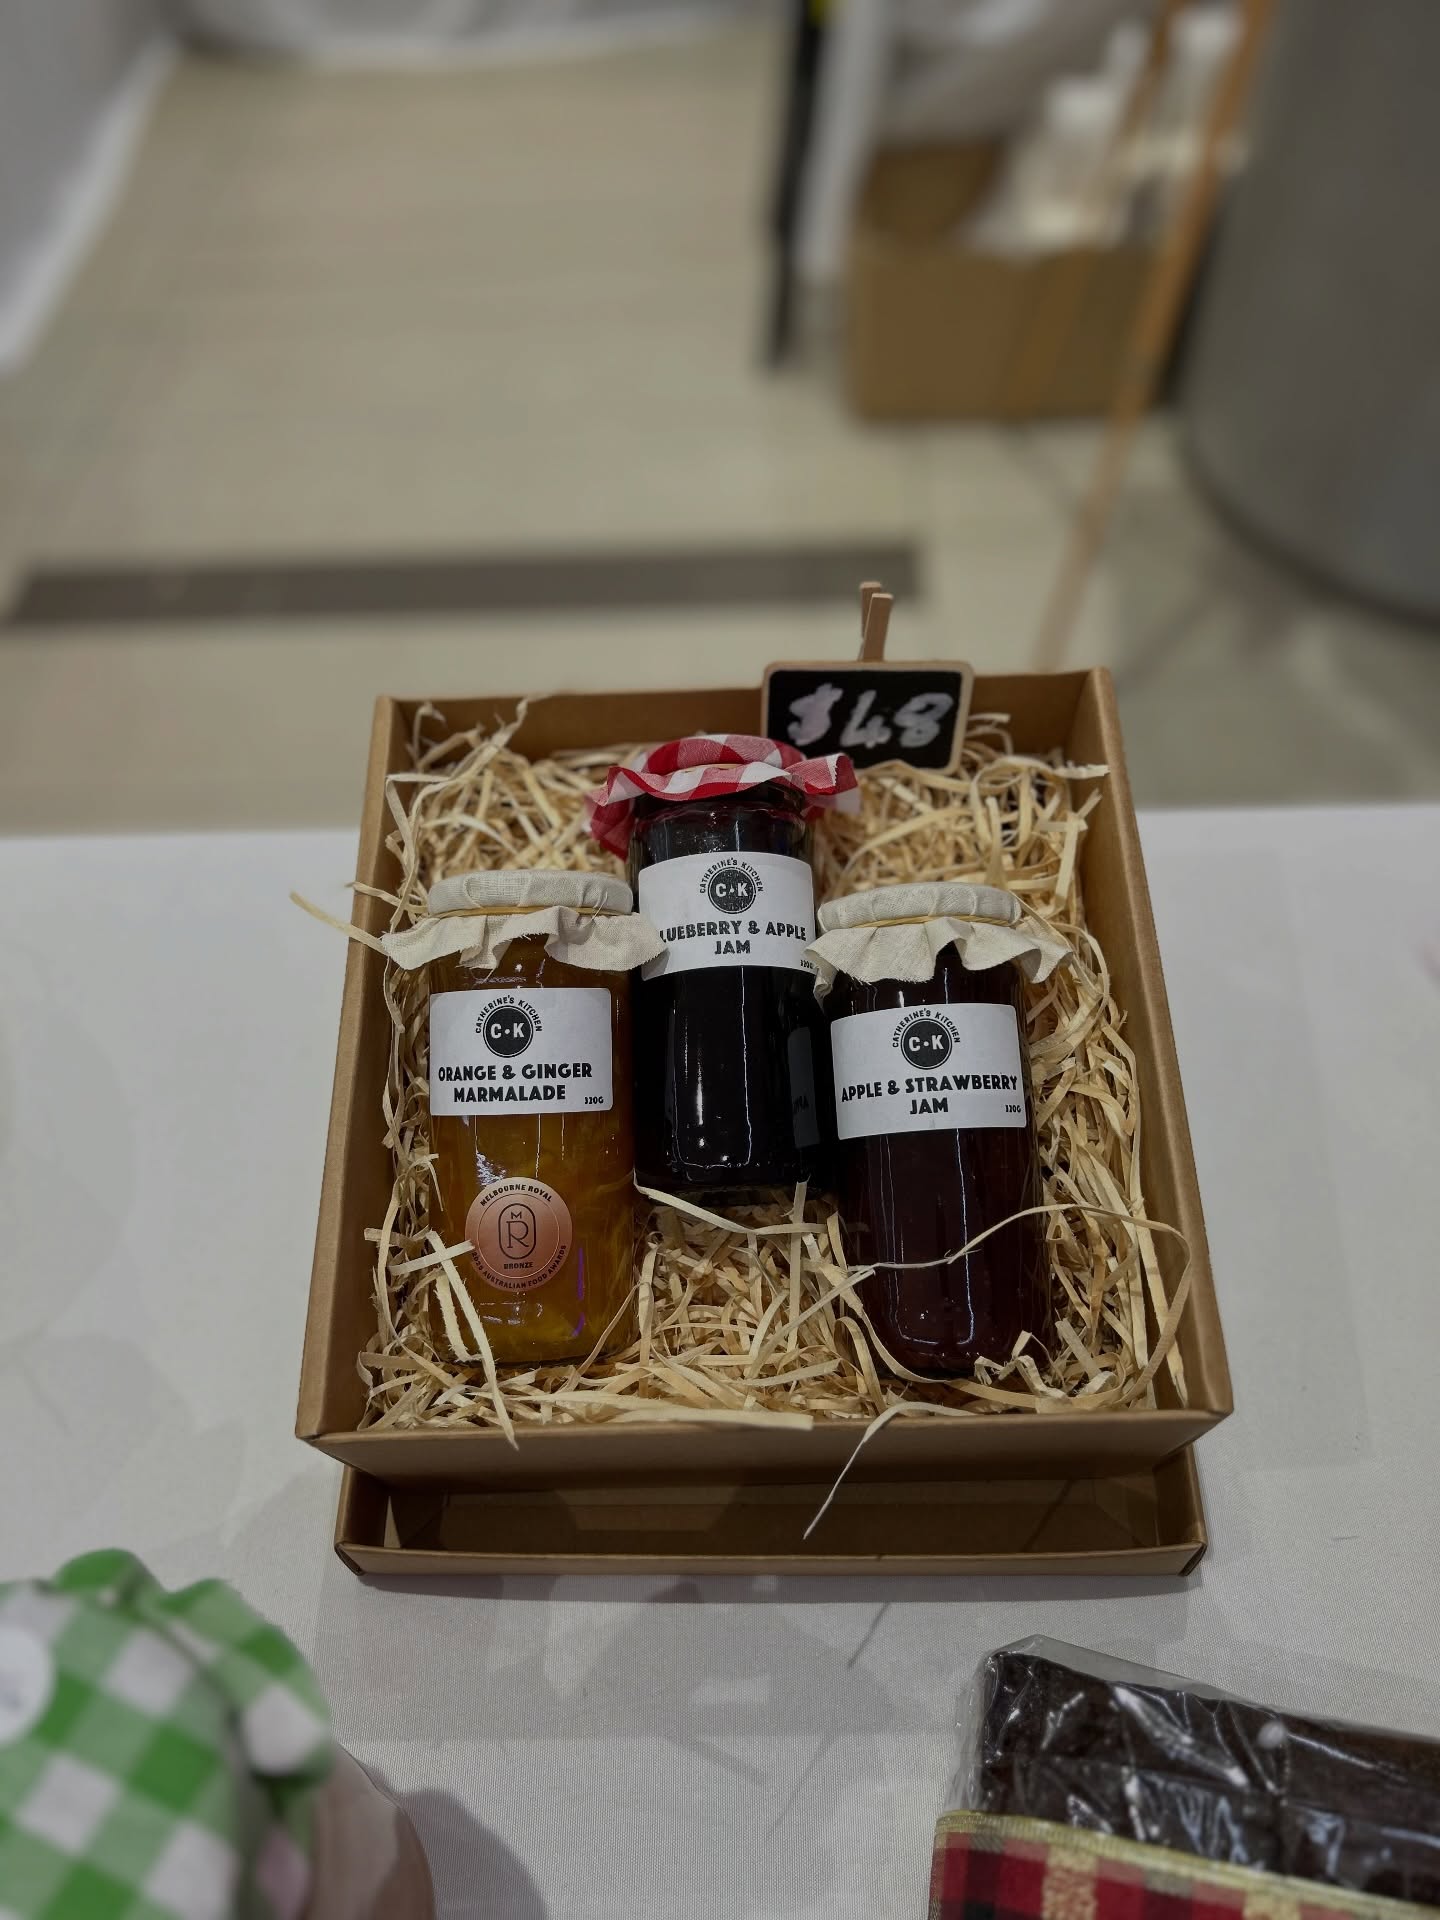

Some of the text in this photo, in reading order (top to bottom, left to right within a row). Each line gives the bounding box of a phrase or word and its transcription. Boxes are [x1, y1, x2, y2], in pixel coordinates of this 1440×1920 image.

[787, 683, 953, 748] $48
[699, 857, 764, 894] CATHERINE'S KITCHEN
[659, 920, 807, 943] LUEBERRY & APPLE
[714, 940, 751, 955] JAM
[475, 994, 543, 1034] CATHERINE'S KITCHEN
[892, 1008, 960, 1048] CATHERINE'S KITCHEN
[438, 1063, 592, 1081] ORANGE & GINGER
[453, 1085, 566, 1102] MARMALADE
[841, 1074, 1018, 1102] APPLE & STRAWBERRY
[909, 1097, 949, 1115] JAM
[480, 1184, 553, 1207] MELBOURNE ROYAL
[482, 1270, 527, 1289] AUSTRALIAN
[528, 1273, 548, 1287] FOOD
[547, 1245, 567, 1275] AWARDS
[503, 1261, 533, 1270] BRONZE
